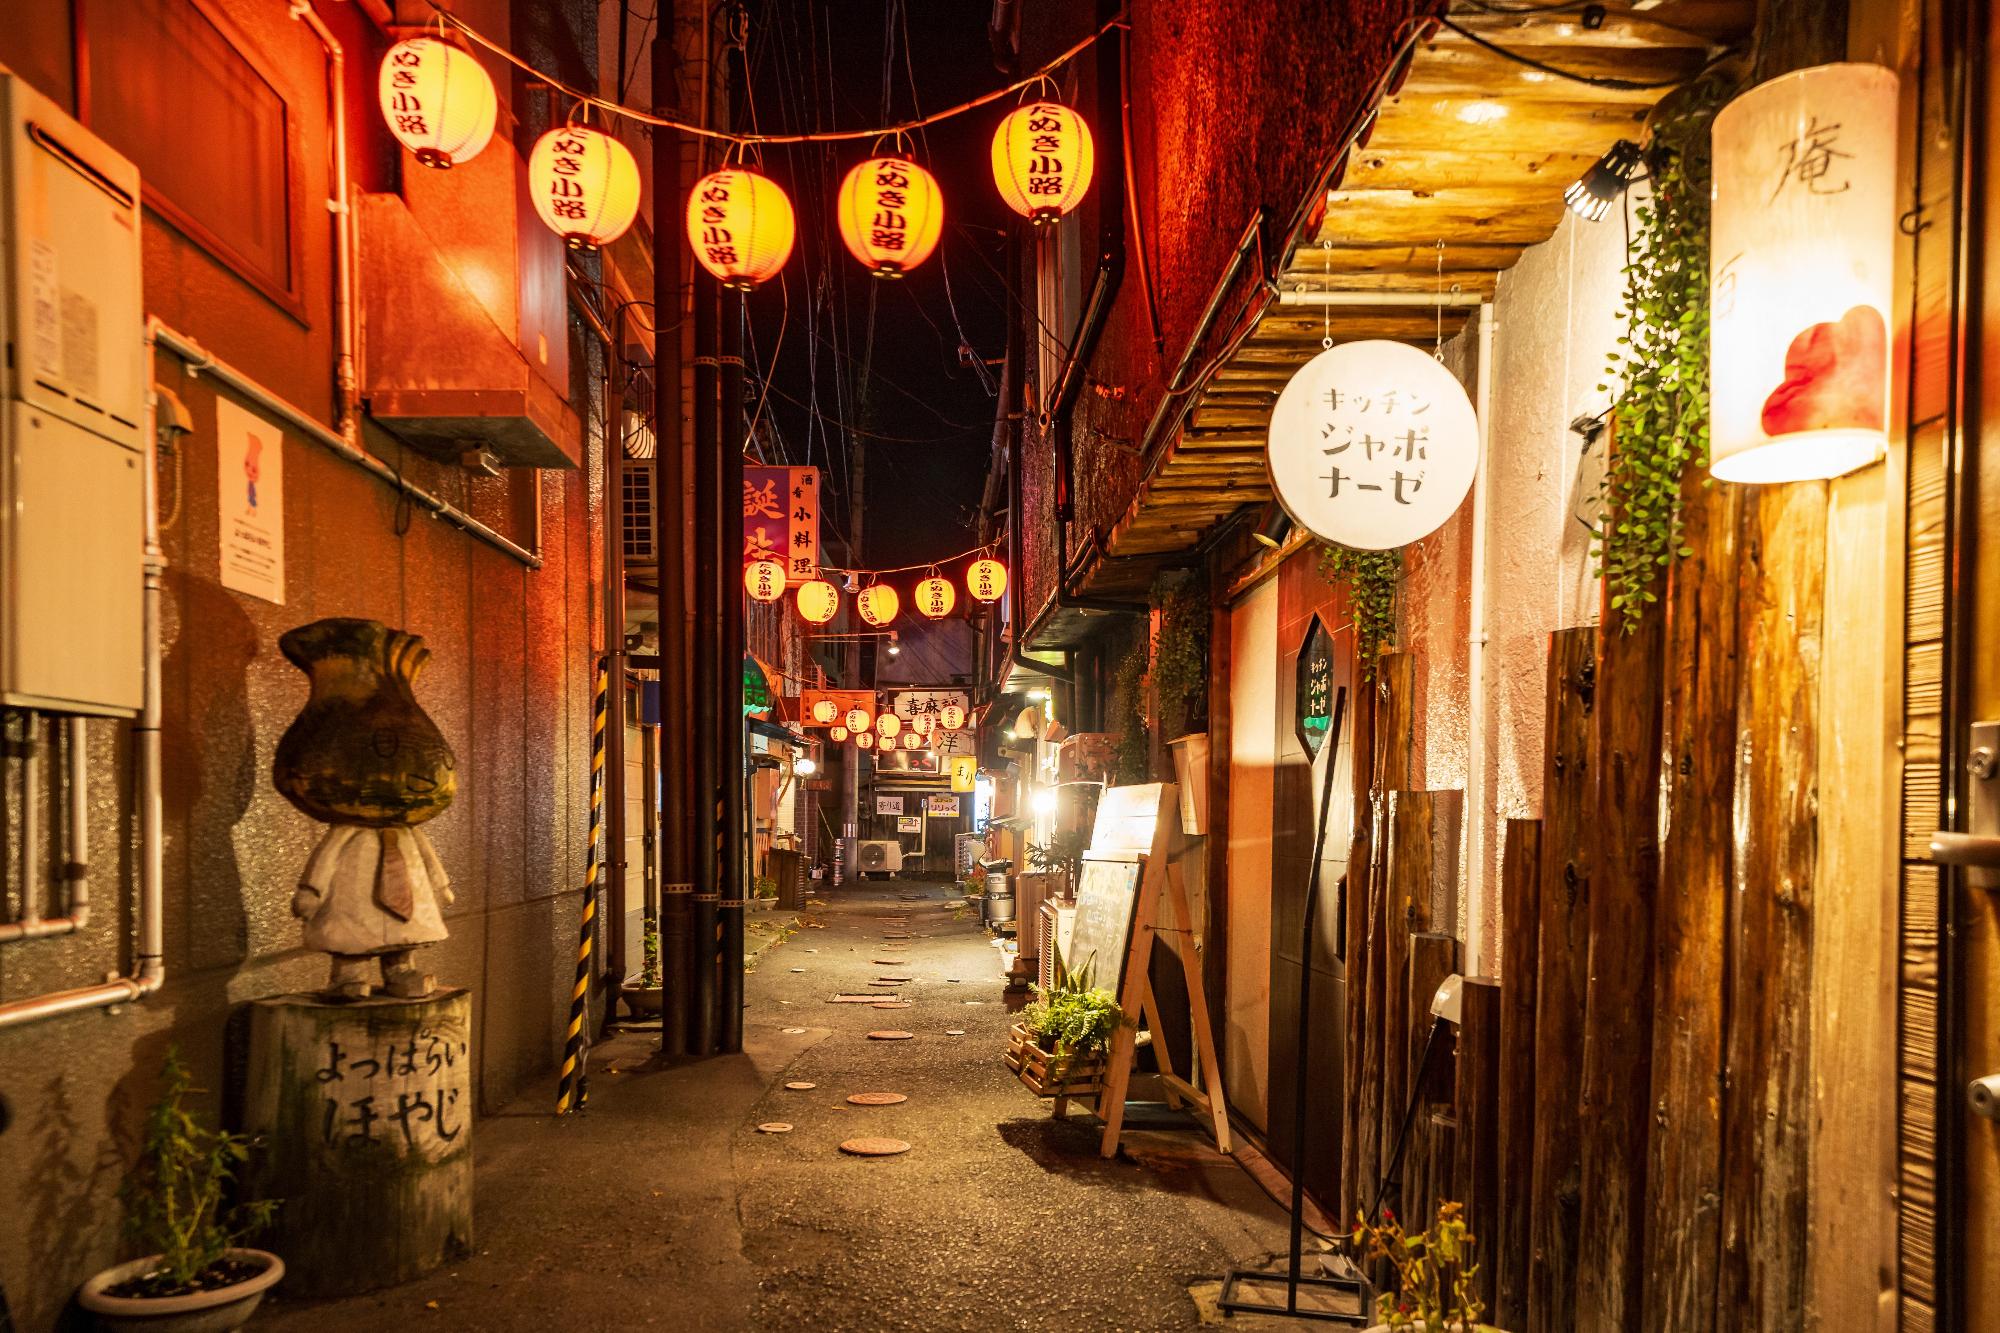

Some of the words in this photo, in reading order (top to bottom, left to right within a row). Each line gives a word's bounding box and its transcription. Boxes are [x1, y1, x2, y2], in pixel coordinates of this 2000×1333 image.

[1028, 104, 1063, 196] たぬき小路
[1767, 116, 1856, 208] 庵
[700, 173, 738, 266] たぬき小路
[871, 160, 909, 251] たぬき小路
[1323, 388, 1430, 415] キッチン
[1321, 422, 1429, 462] ジャポ
[1319, 466, 1425, 505] ナーゼ
[744, 479, 785, 568] 誕生
[758, 564, 772, 597] たぬき小路
[930, 580, 944, 613] たぬき小路
[979, 562, 993, 596] たぬき小路
[937, 732, 959, 753] 洋
[879, 801, 901, 811] 寄り道
[930, 804, 957, 813] りりっく
[316, 1027, 466, 1084] よっぱらい
[324, 1087, 461, 1150] ほやじ
